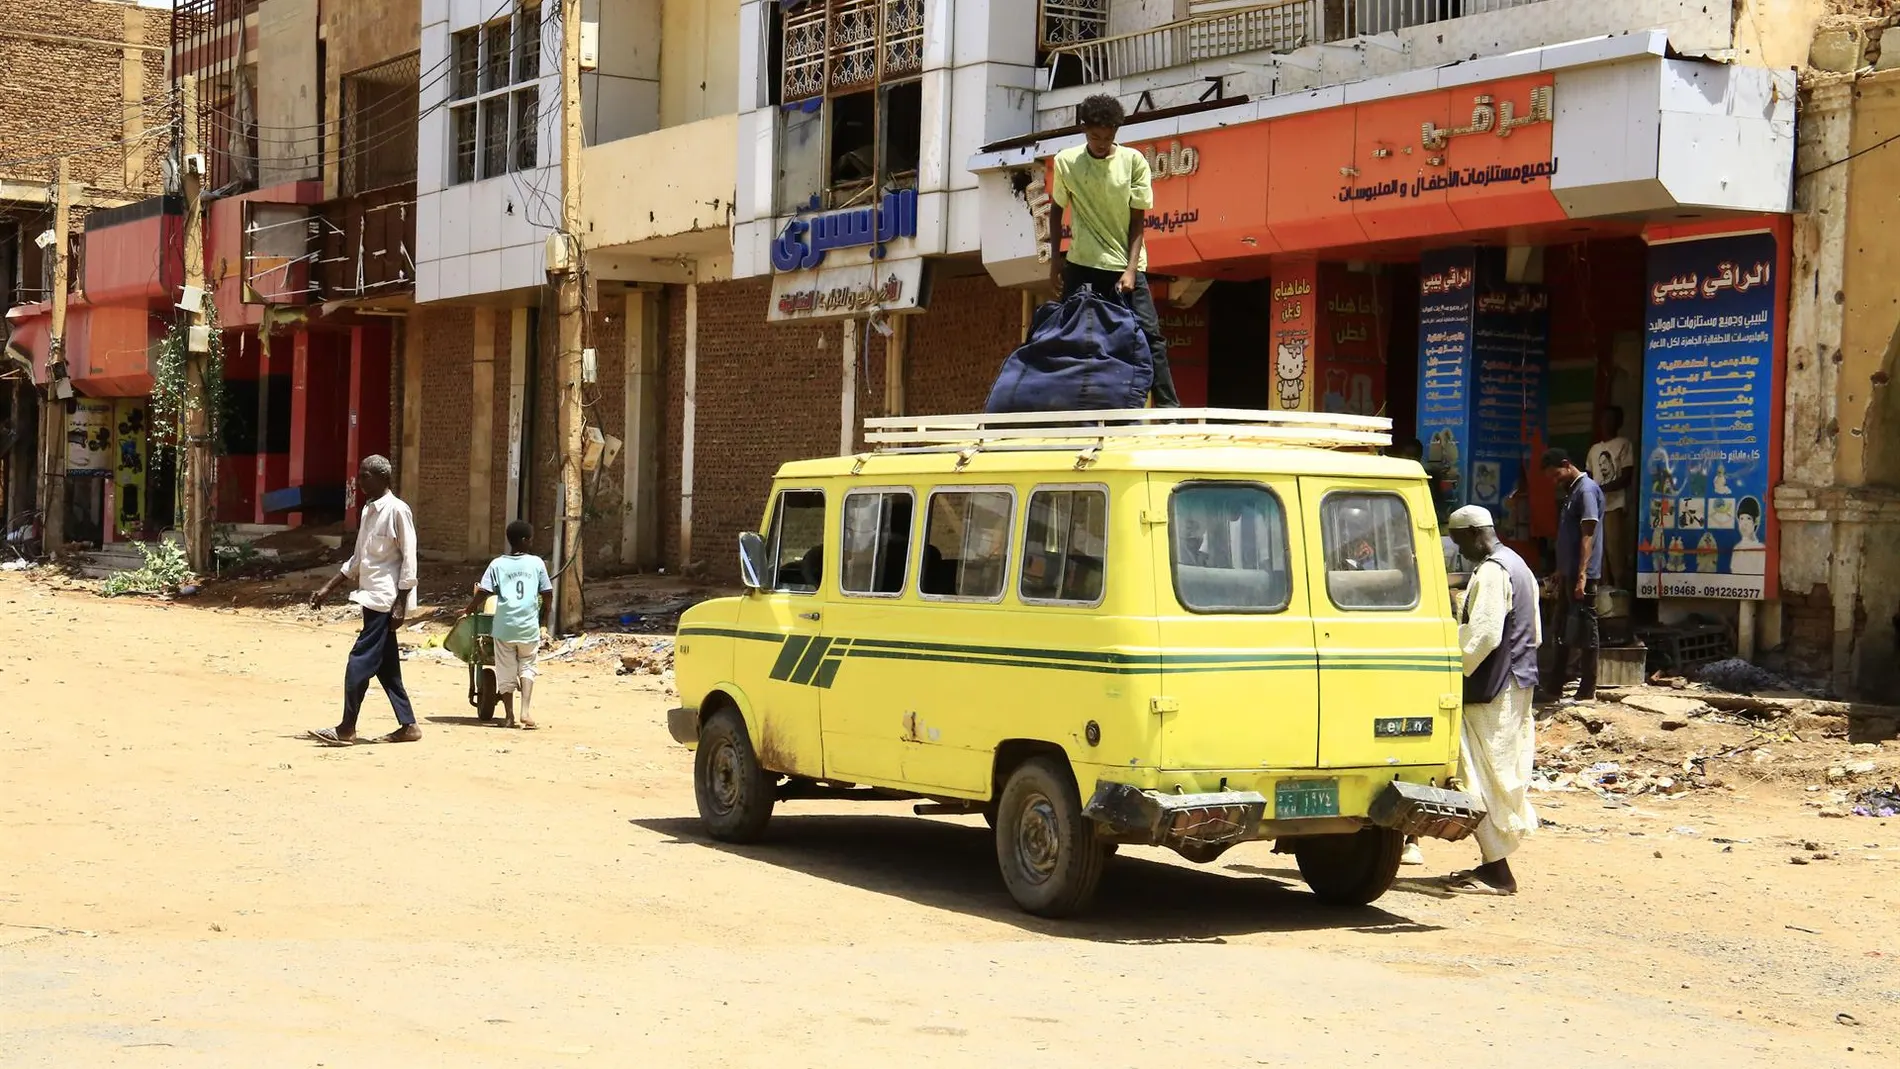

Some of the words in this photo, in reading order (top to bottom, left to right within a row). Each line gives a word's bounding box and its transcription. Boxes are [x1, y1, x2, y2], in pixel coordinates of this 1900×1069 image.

[1411, 165, 1460, 198] الأطفال
[1460, 164, 1521, 186] مستلزمات
[1521, 157, 1558, 184] لجميع
[1338, 180, 1399, 202] الملبوسات
[1399, 184, 1407, 197] و
[1653, 272, 1698, 305] بيبي
[1702, 262, 1771, 298] الراقي
[1677, 315, 1717, 331] مستلزمات
[1718, 314, 1743, 329] وجميع
[516, 580, 525, 600] 9
[1641, 586, 1696, 596] 091819468
[1703, 586, 1761, 598] 0912262377
